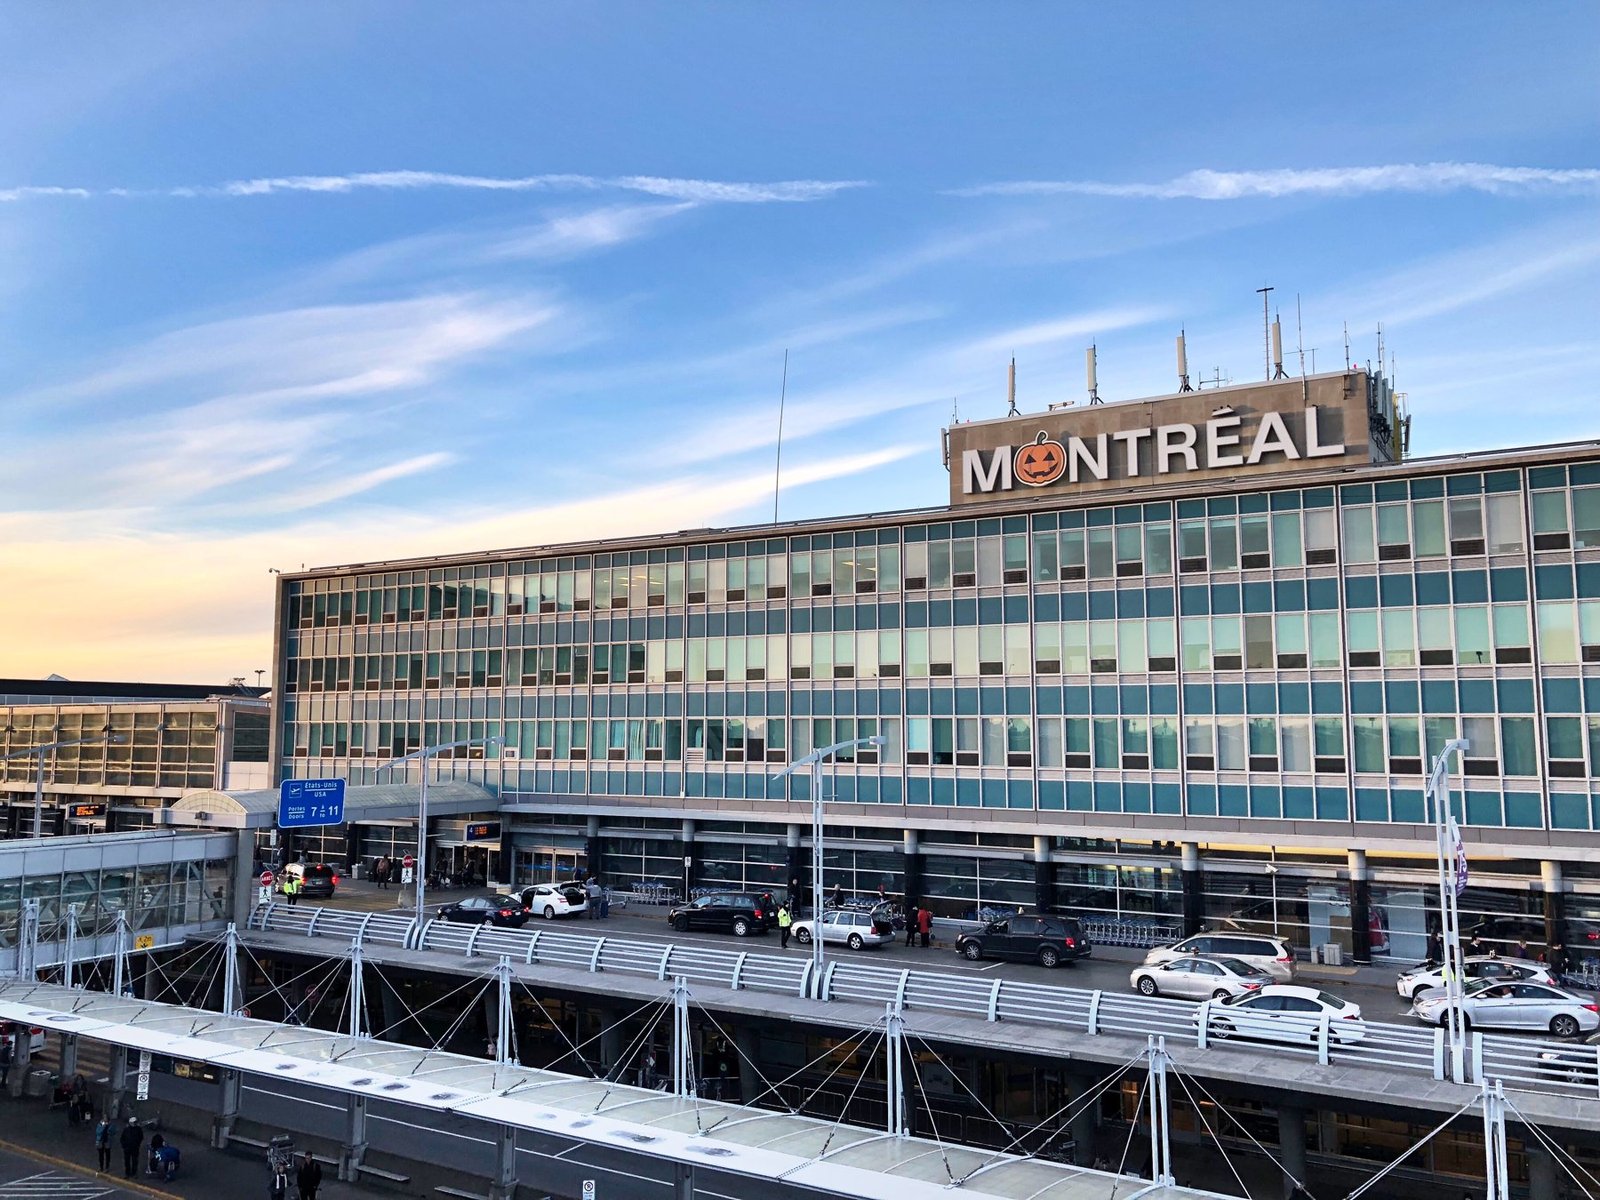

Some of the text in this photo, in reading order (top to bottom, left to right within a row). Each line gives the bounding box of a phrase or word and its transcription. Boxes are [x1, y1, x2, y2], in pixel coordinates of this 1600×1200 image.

[962, 406, 1346, 494] MNTRÉAL
[304, 781, 337, 789] États-Unis
[311, 806, 318, 817] 7
[328, 805, 338, 816] 11
